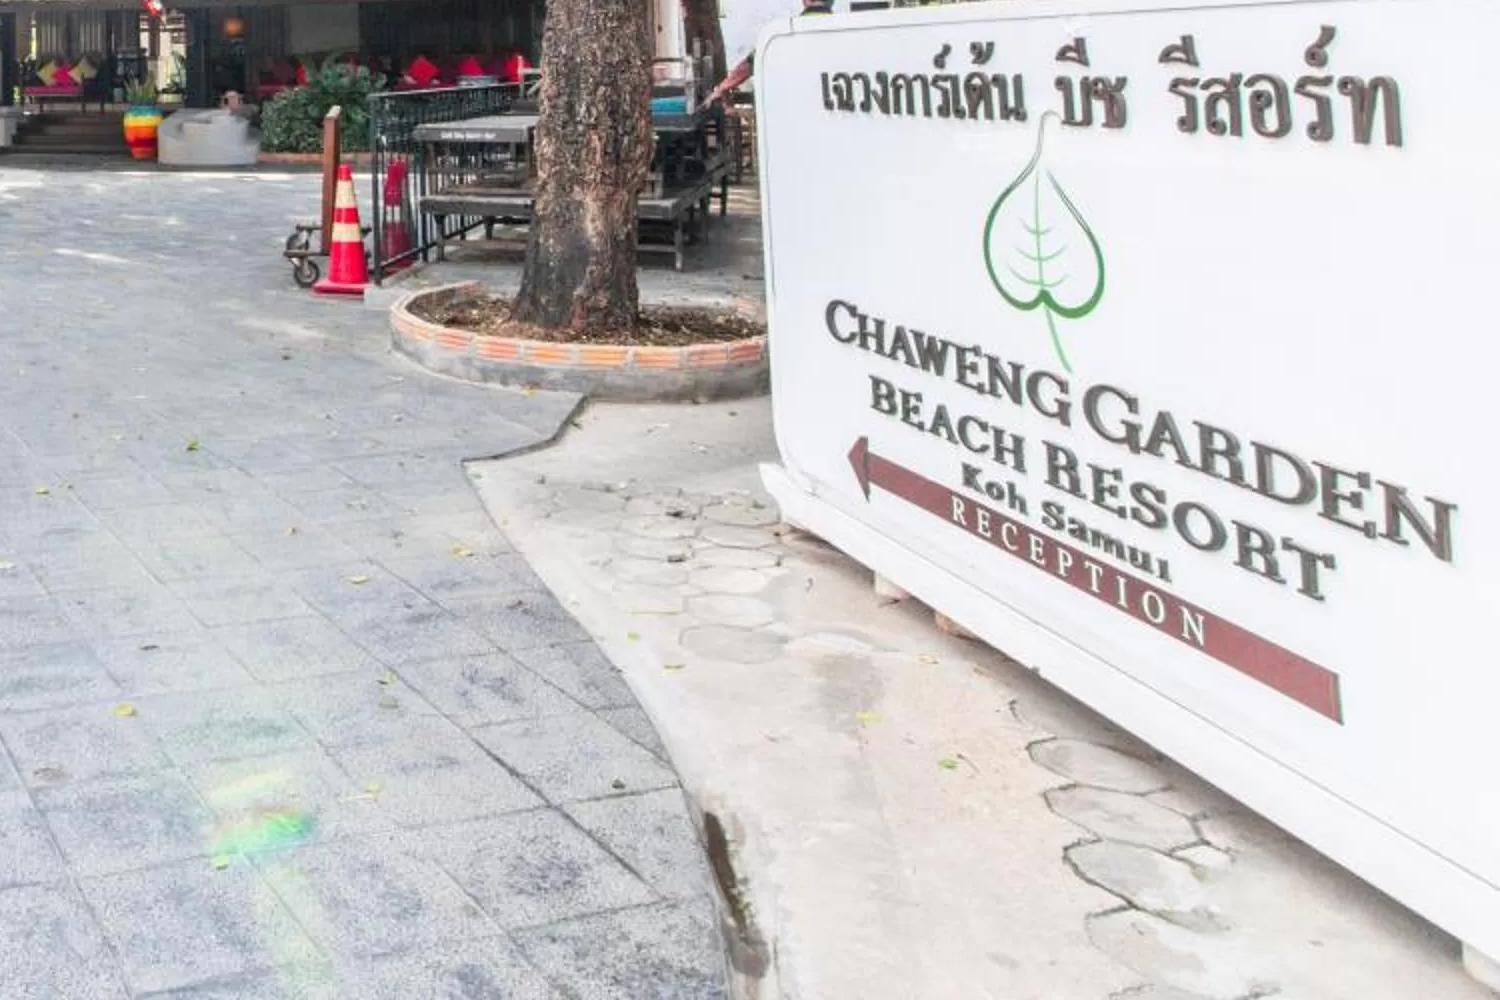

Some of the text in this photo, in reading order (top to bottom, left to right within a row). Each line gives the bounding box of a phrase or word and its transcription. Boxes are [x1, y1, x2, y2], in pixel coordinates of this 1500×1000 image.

[1157, 24, 1404, 148] รีสอร์ท
[824, 298, 1458, 562] CHAWENG GARDEN
[868, 373, 1337, 603] BEACH RESORT
[950, 494, 1206, 647] RECEPTION
[960, 462, 1173, 585] Koh Samui
